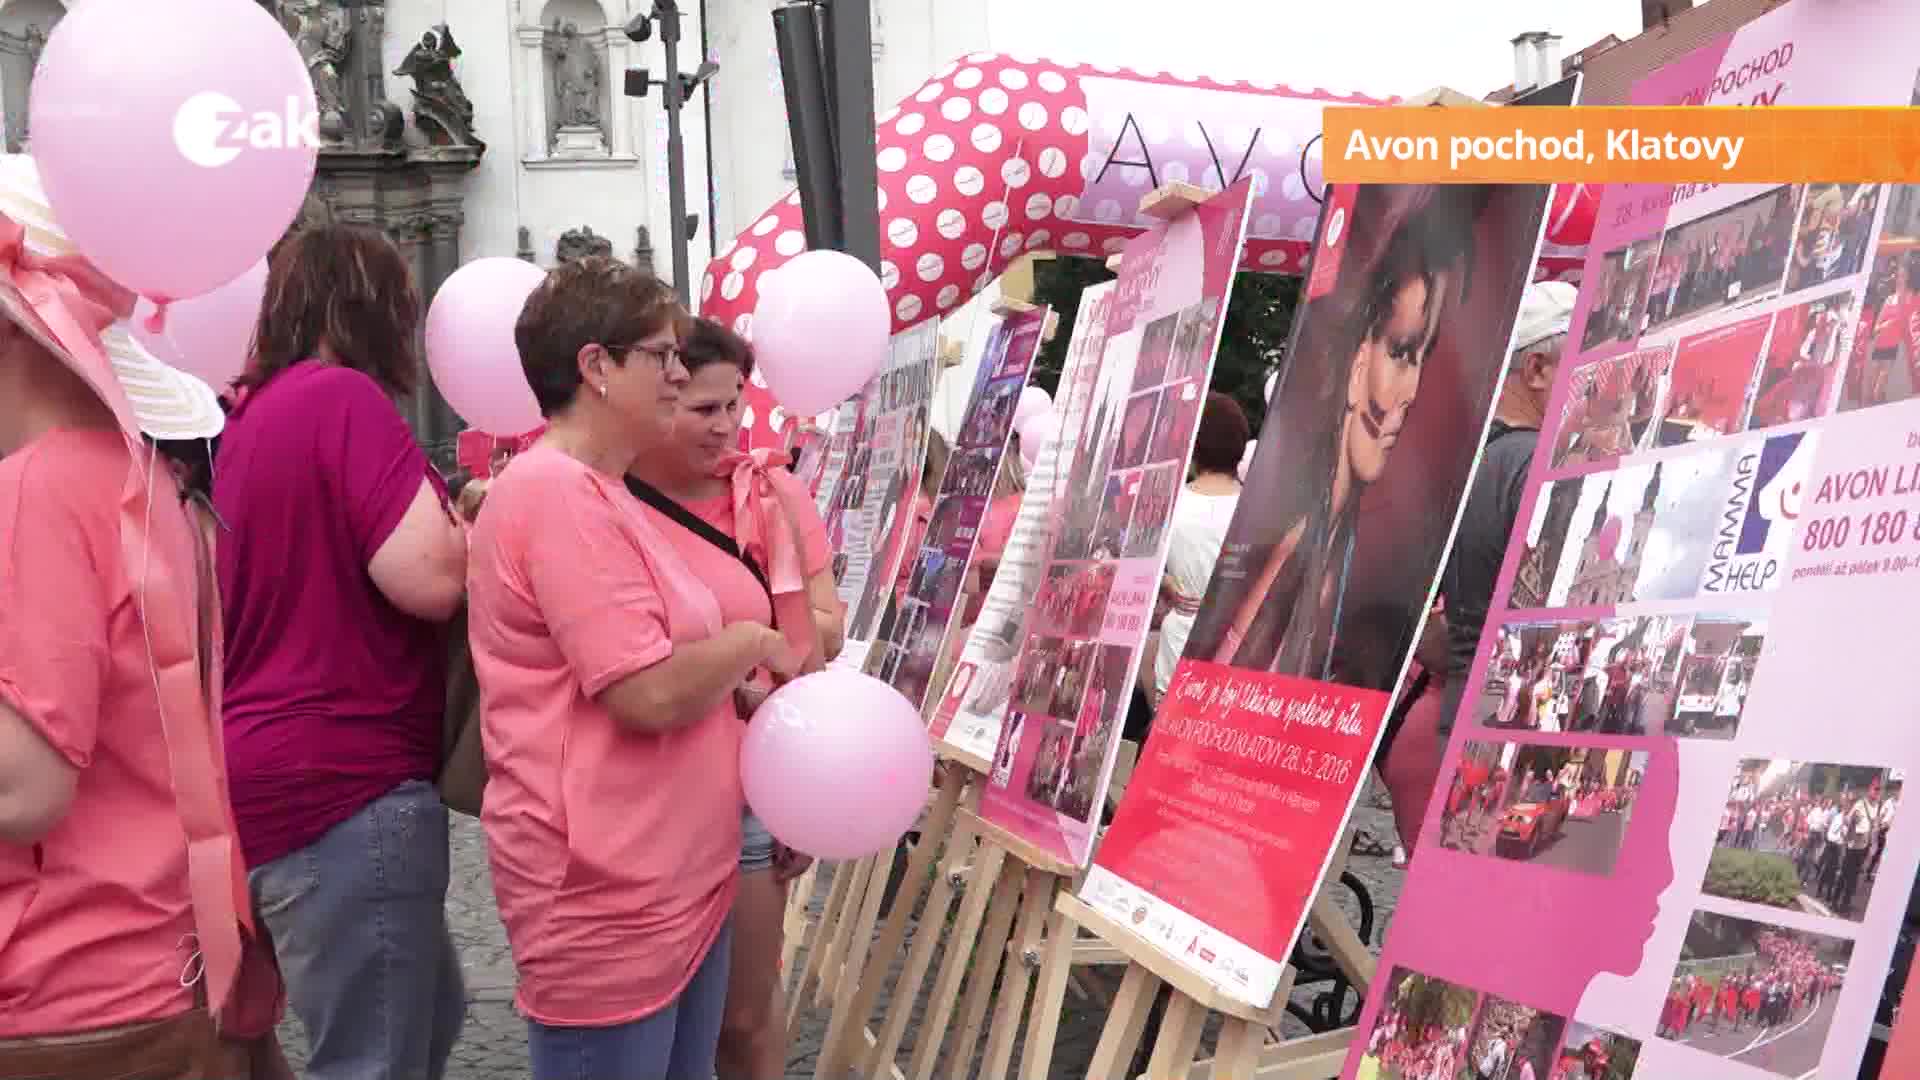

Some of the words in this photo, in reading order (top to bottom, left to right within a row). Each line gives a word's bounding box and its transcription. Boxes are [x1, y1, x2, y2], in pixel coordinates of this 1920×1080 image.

[1709, 42, 1794, 103] POCHOD
[1814, 467, 1888, 504] AVON
[1893, 461, 1920, 495] LI
[1703, 453, 1758, 592] MAMMA
[1803, 515, 1850, 551] 800
[1860, 509, 1907, 545] 180
[1723, 559, 1777, 592] HELP
[1301, 749, 1319, 776] 5.
[1314, 752, 1353, 784] 2016
